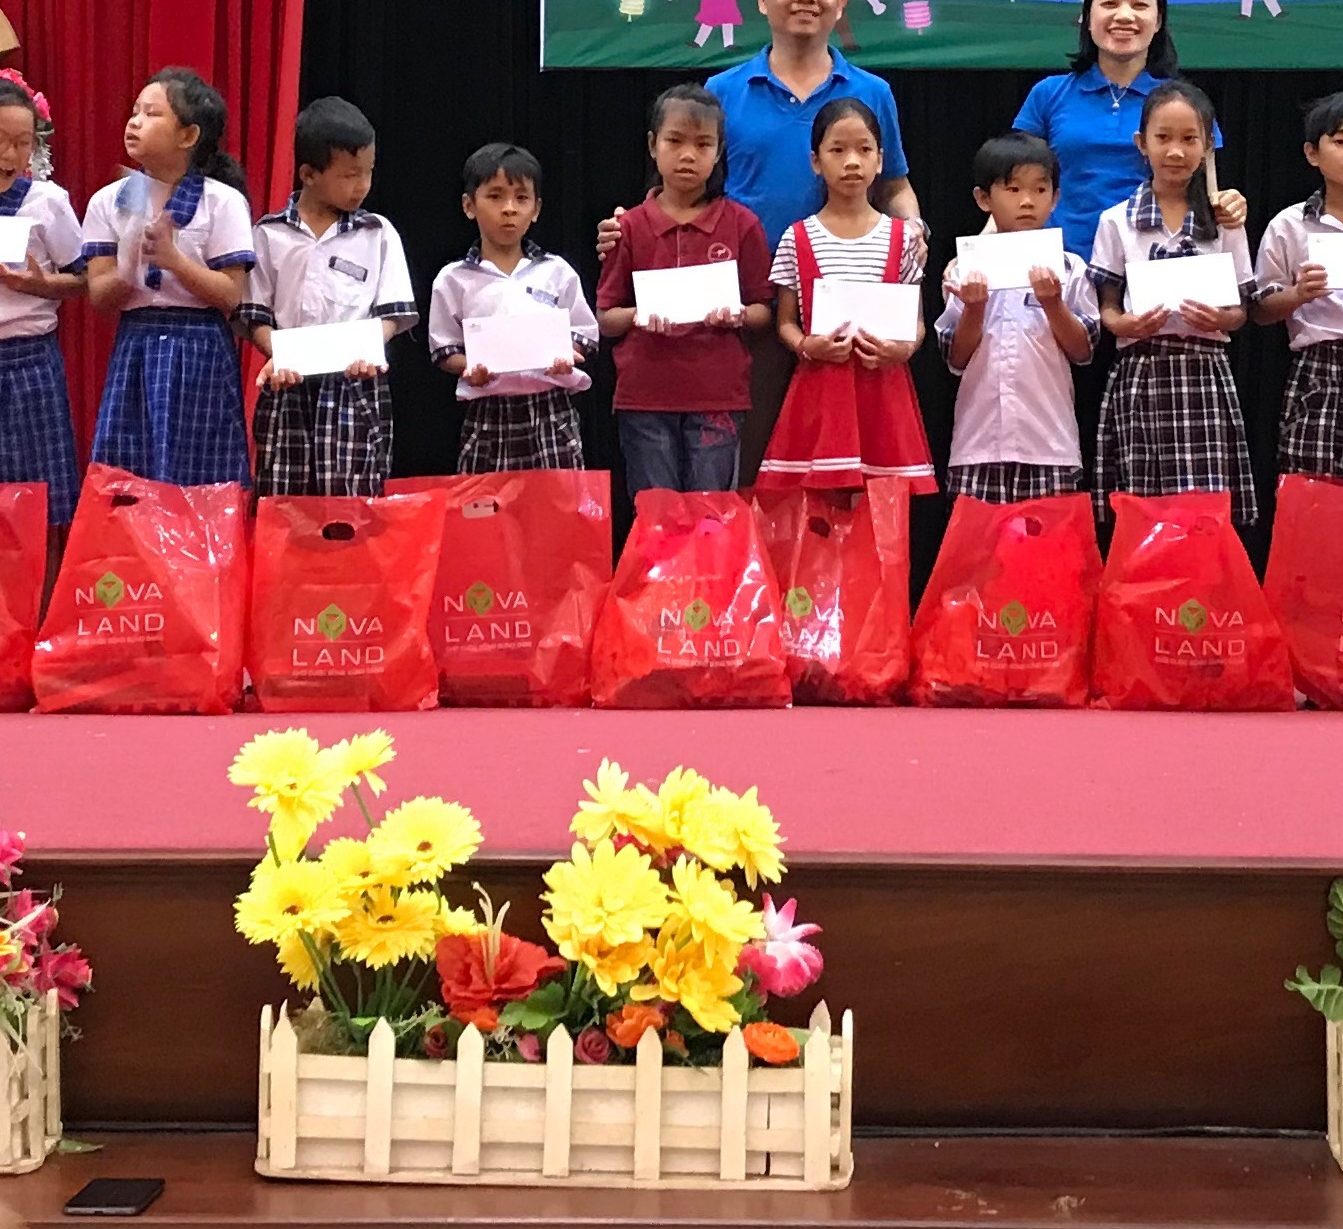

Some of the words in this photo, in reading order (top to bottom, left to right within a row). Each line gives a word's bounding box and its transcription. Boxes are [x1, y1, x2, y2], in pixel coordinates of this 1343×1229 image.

[78, 613, 165, 636] LAND
[445, 620, 532, 642] LAND
[293, 646, 384, 666] LAND
[657, 636, 740, 657] LAND
[977, 640, 1058, 660] LAND
[1156, 637, 1244, 657] LAND
